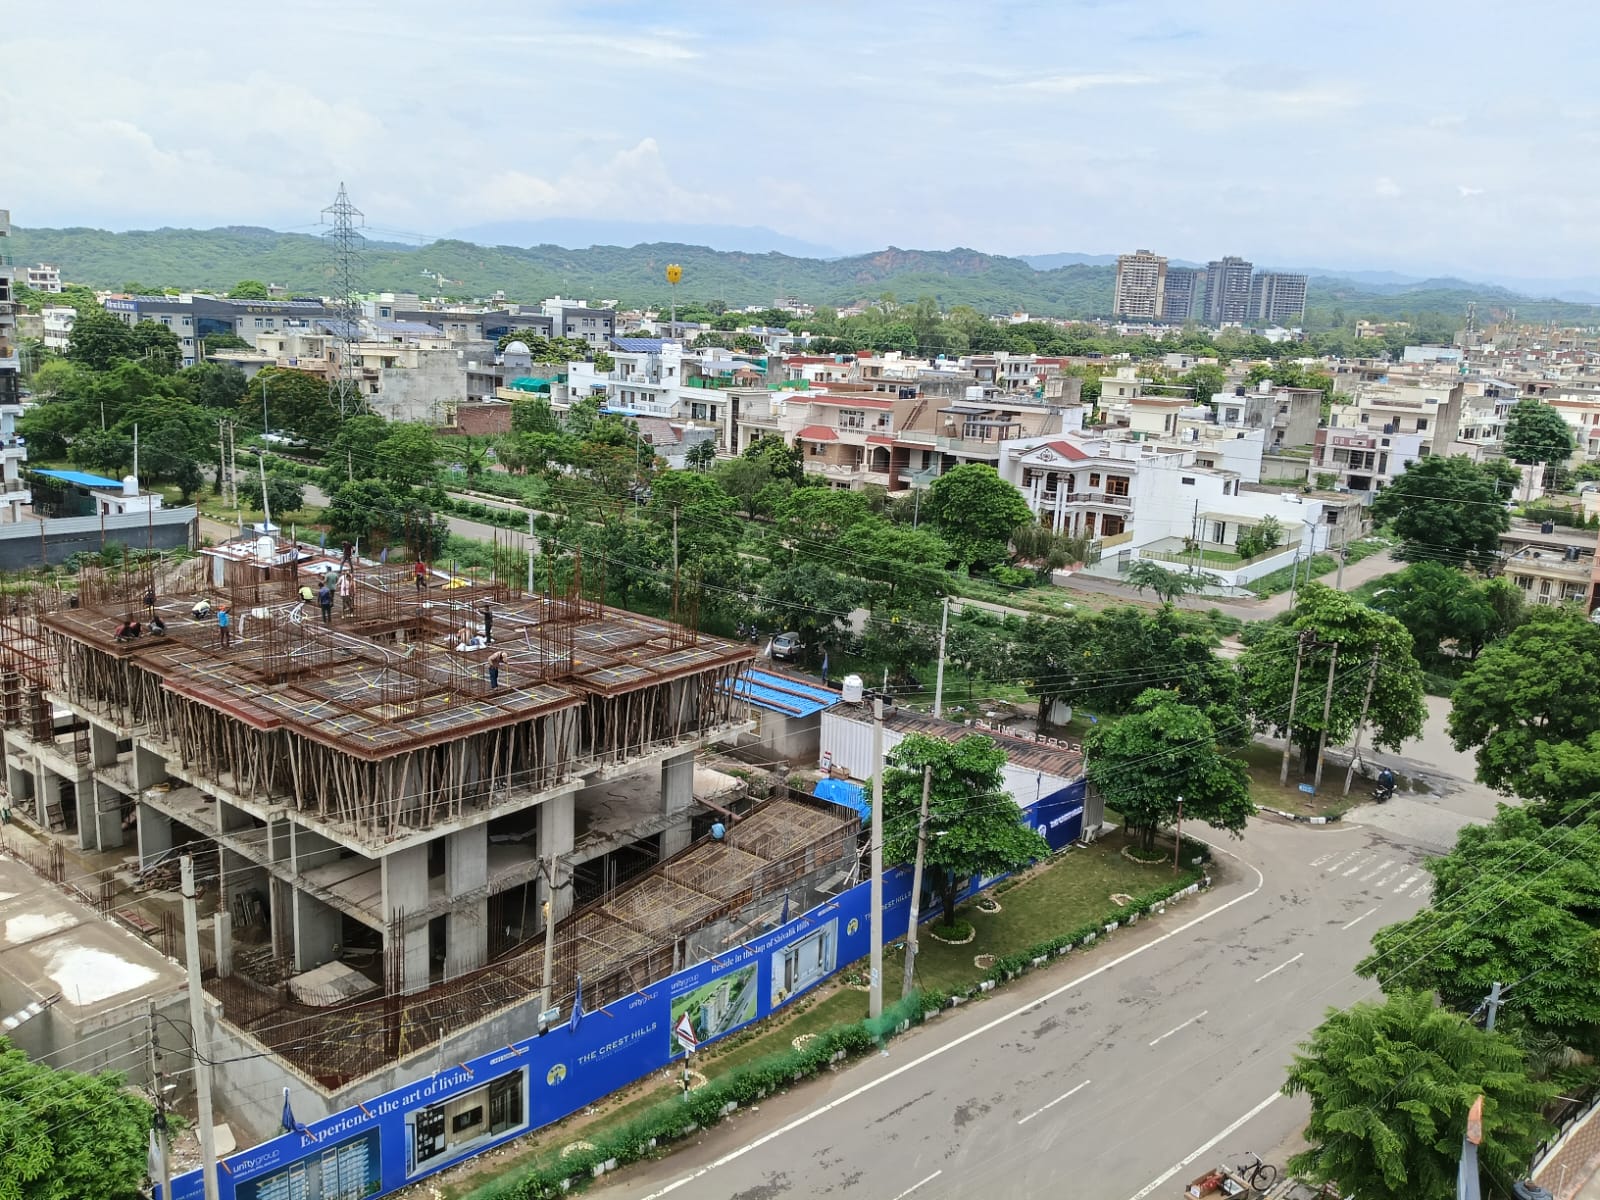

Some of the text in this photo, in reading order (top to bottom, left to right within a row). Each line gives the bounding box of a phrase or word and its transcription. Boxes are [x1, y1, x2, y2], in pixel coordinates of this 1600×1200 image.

[711, 955, 734, 974] Reside
[743, 948, 754, 961] the
[766, 939, 774, 950] of
[773, 927, 796, 945] Shivalik
[796, 919, 810, 935] Hills
[577, 1050, 597, 1065] THE
[599, 1035, 630, 1055] CREST
[631, 1022, 657, 1040] HILLS
[300, 1071, 474, 1148] Experience the art of living
